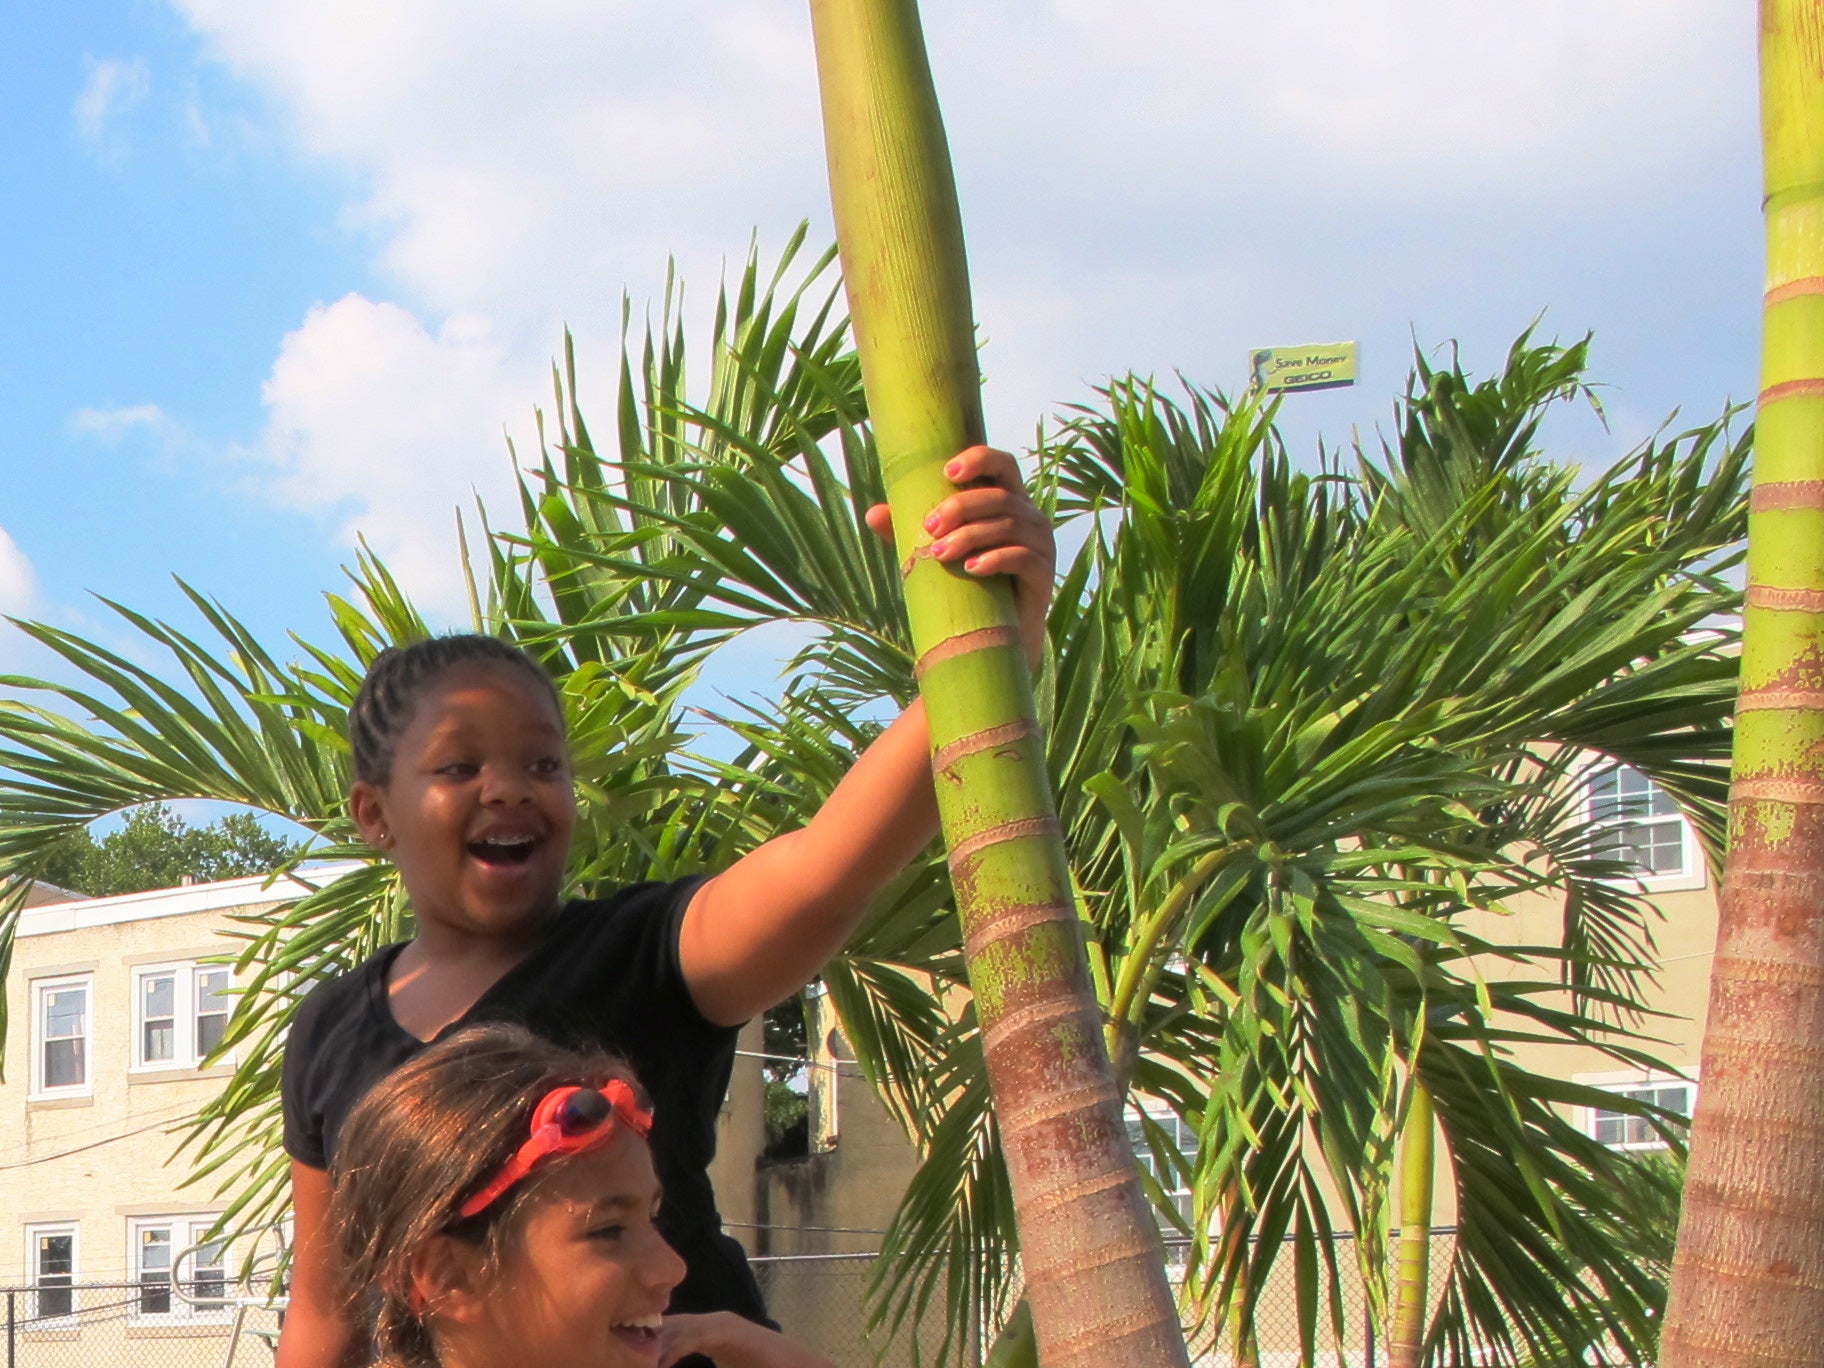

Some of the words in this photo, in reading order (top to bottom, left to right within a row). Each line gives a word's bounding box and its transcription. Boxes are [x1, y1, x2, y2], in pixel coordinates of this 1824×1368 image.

[1276, 358, 1303, 369] Save
[1306, 355, 1347, 367] Money
[1284, 371, 1332, 384] GEICO
